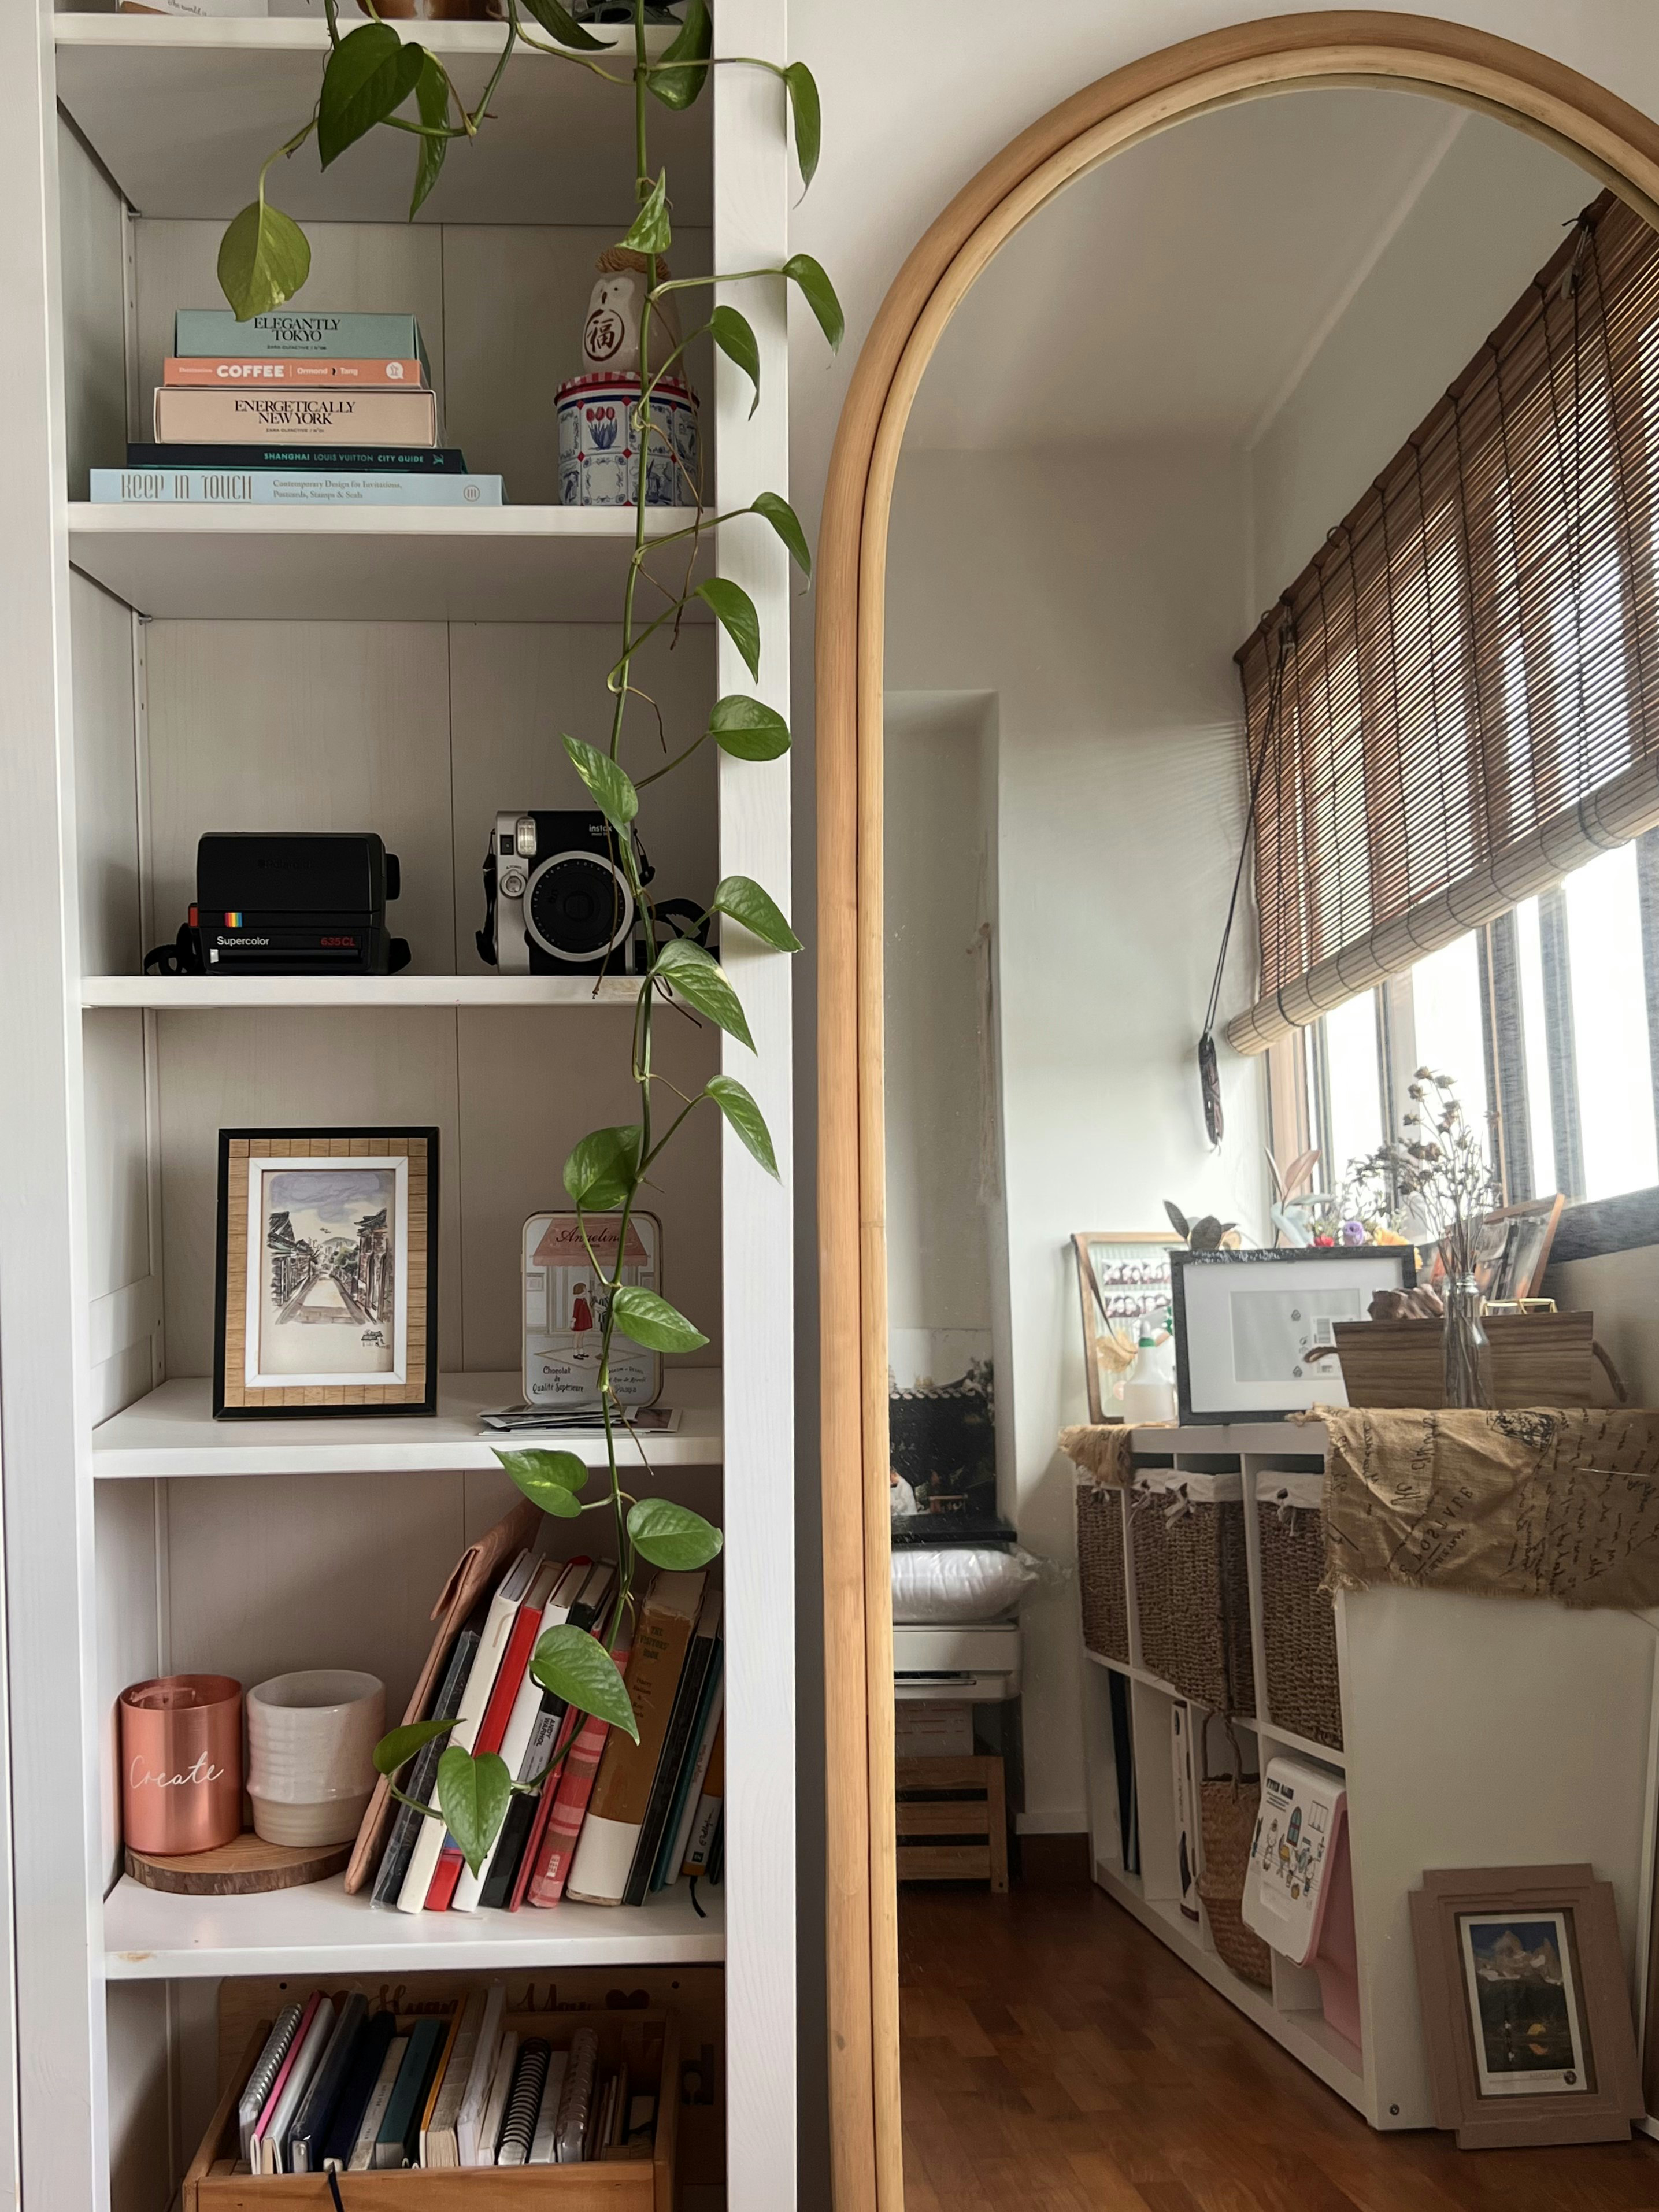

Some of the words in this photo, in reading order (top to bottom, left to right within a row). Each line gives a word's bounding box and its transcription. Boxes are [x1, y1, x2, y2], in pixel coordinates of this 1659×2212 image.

[254, 317, 341, 331] ELEGANTLY
[272, 329, 322, 342] TOKYO
[587, 318, 616, 352] 福
[217, 365, 284, 377] COFFEE
[297, 367, 328, 375] Ormond
[340, 368, 358, 376] Tang
[235, 399, 356, 413] ENERGETICALLY
[258, 413, 293, 424] NEW
[296, 413, 333, 425] YORK
[273, 480, 323, 489] Contemporary
[325, 480, 349, 489] Design
[310, 491, 335, 500] Stamps
[217, 936, 270, 947] Supercolor
[321, 937, 356, 946] 635CL
[556, 1226, 621, 1248] Anelin
[543, 1365, 571, 1374] Chocolat
[535, 1717, 550, 1747] WARHOL
[545, 1718, 556, 1738] ANDY
[130, 1751, 224, 1789] Create
